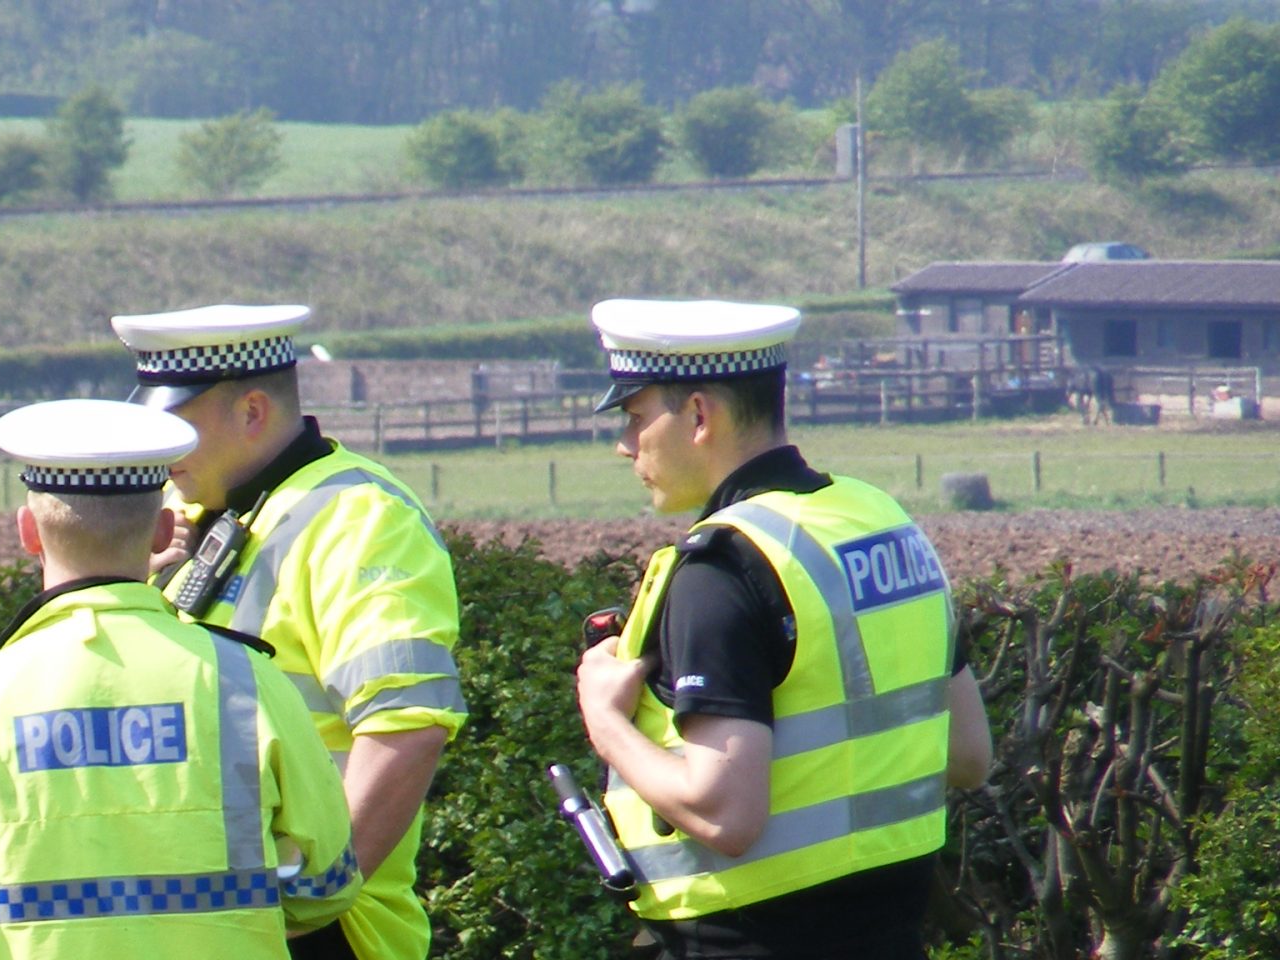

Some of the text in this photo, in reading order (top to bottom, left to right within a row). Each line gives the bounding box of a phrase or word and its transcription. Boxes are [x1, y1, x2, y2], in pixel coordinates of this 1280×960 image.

[845, 534, 939, 600] POLICE
[676, 675, 704, 690] LICE
[22, 706, 179, 769] POLICE
